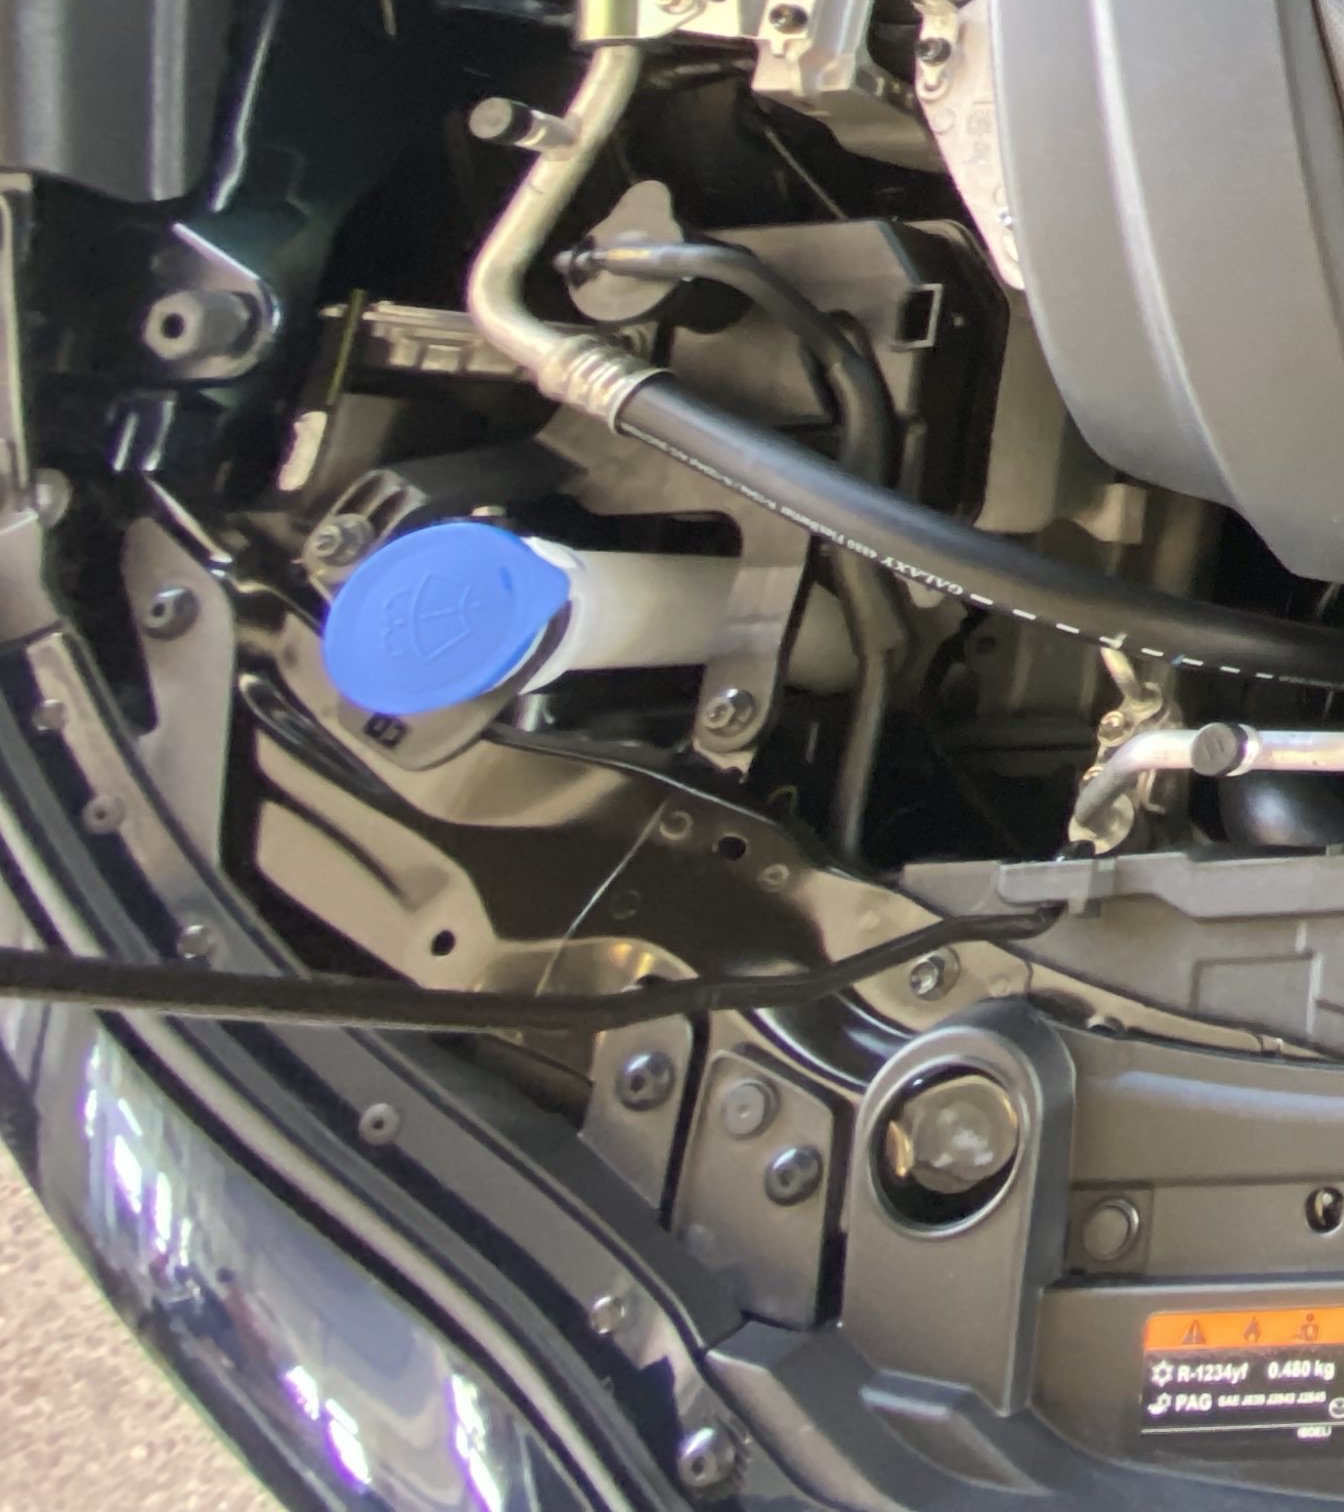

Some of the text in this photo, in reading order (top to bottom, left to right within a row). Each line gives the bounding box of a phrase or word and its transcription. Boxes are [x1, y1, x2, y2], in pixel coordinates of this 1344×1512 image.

[881, 556, 963, 595] GALAXY
[1177, 1363, 1249, 1384] R-1234yf
[1314, 1359, 1335, 1381] kg
[1175, 1393, 1212, 1412] PAG
